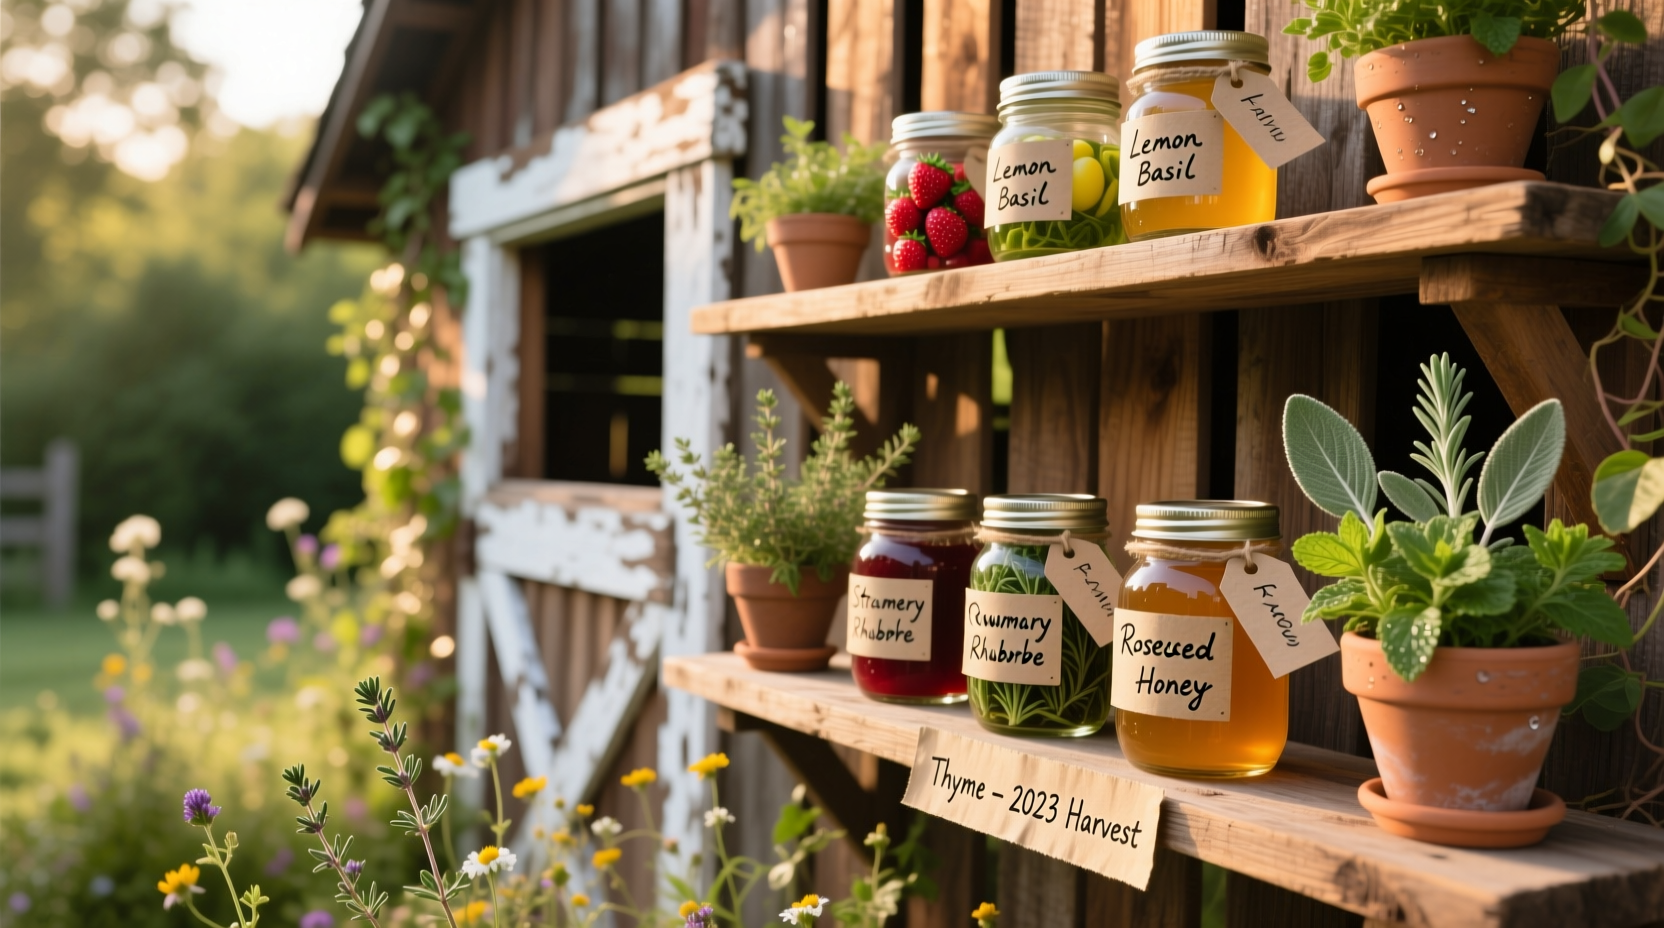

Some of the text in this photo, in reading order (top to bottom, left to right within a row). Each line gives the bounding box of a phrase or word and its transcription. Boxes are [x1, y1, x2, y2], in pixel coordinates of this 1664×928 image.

[1130, 129, 1203, 159] Lemon
[993, 159, 1056, 183] Lemon
[1137, 153, 1196, 188] Basil
[998, 181, 1050, 211] Basil
[1135, 665, 1213, 711] Honey
[931, 756, 986, 803] Thyme
[1008, 785, 1059, 823] 2023
[1064, 797, 1143, 849] Harvest
